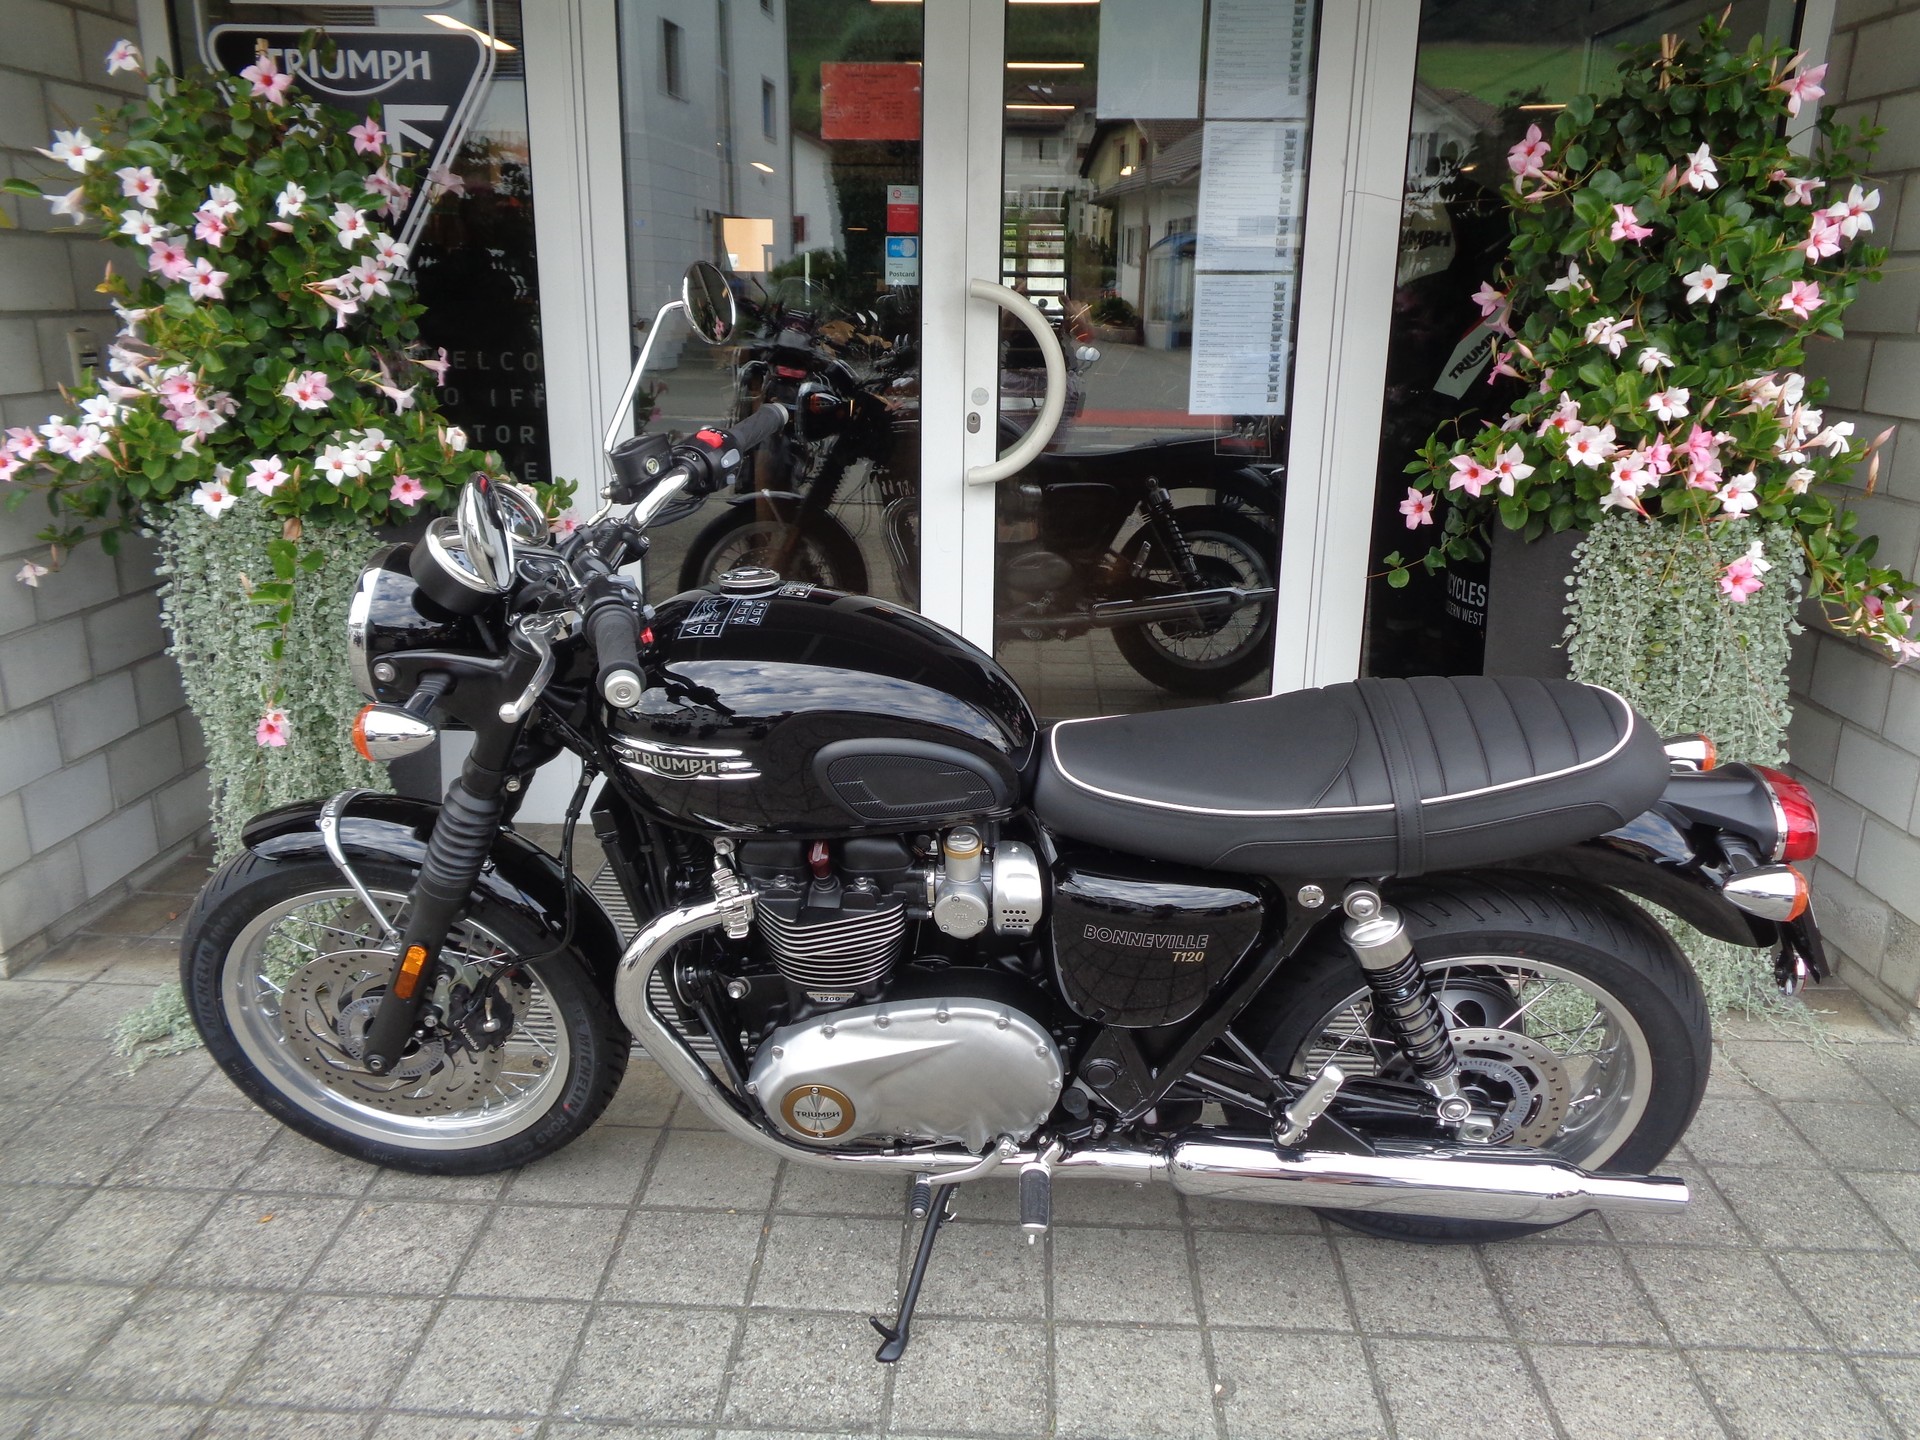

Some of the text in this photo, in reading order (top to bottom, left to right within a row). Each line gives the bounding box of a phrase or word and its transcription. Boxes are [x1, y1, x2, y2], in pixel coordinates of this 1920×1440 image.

[256, 48, 431, 95] TRIUMPH
[888, 270, 915, 278] Postcard
[453, 351, 538, 372] ELCO
[472, 424, 536, 445] TOR
[1462, 608, 1485, 626] WEST
[631, 748, 717, 778] TRIUMPH
[1083, 923, 1209, 949] BONNEVILLE
[1172, 951, 1205, 962] T120
[196, 946, 217, 1029] MICHELIN
[567, 1032, 593, 1118] MICHELIN
[795, 1110, 840, 1120] TRIUMPH
